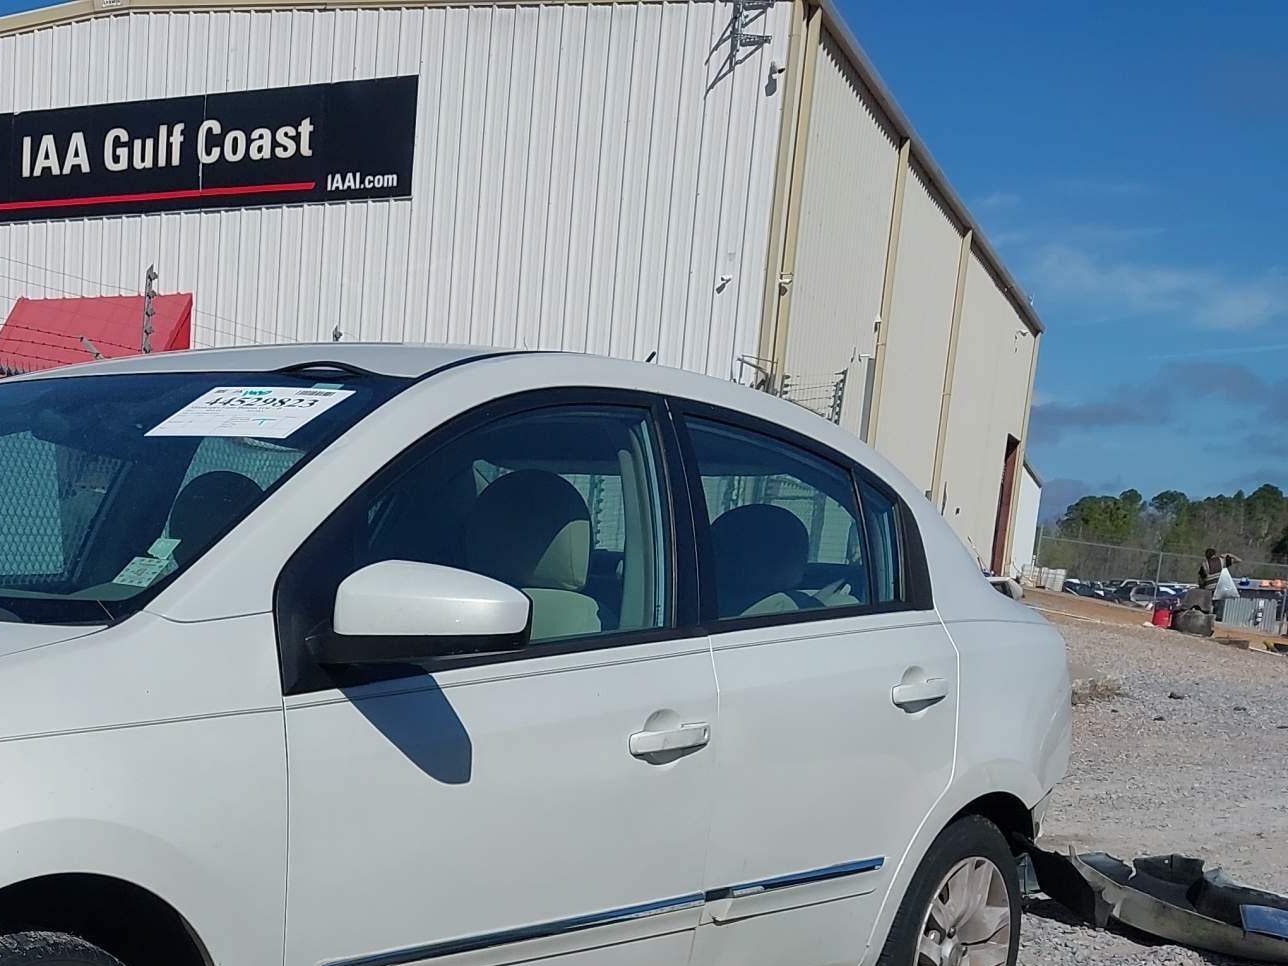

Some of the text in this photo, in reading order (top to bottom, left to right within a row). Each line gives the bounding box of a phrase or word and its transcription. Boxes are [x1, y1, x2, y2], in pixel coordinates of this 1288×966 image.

[22, 117, 314, 178] IAA Gulf Coast
[326, 172, 398, 191] IAAI.com
